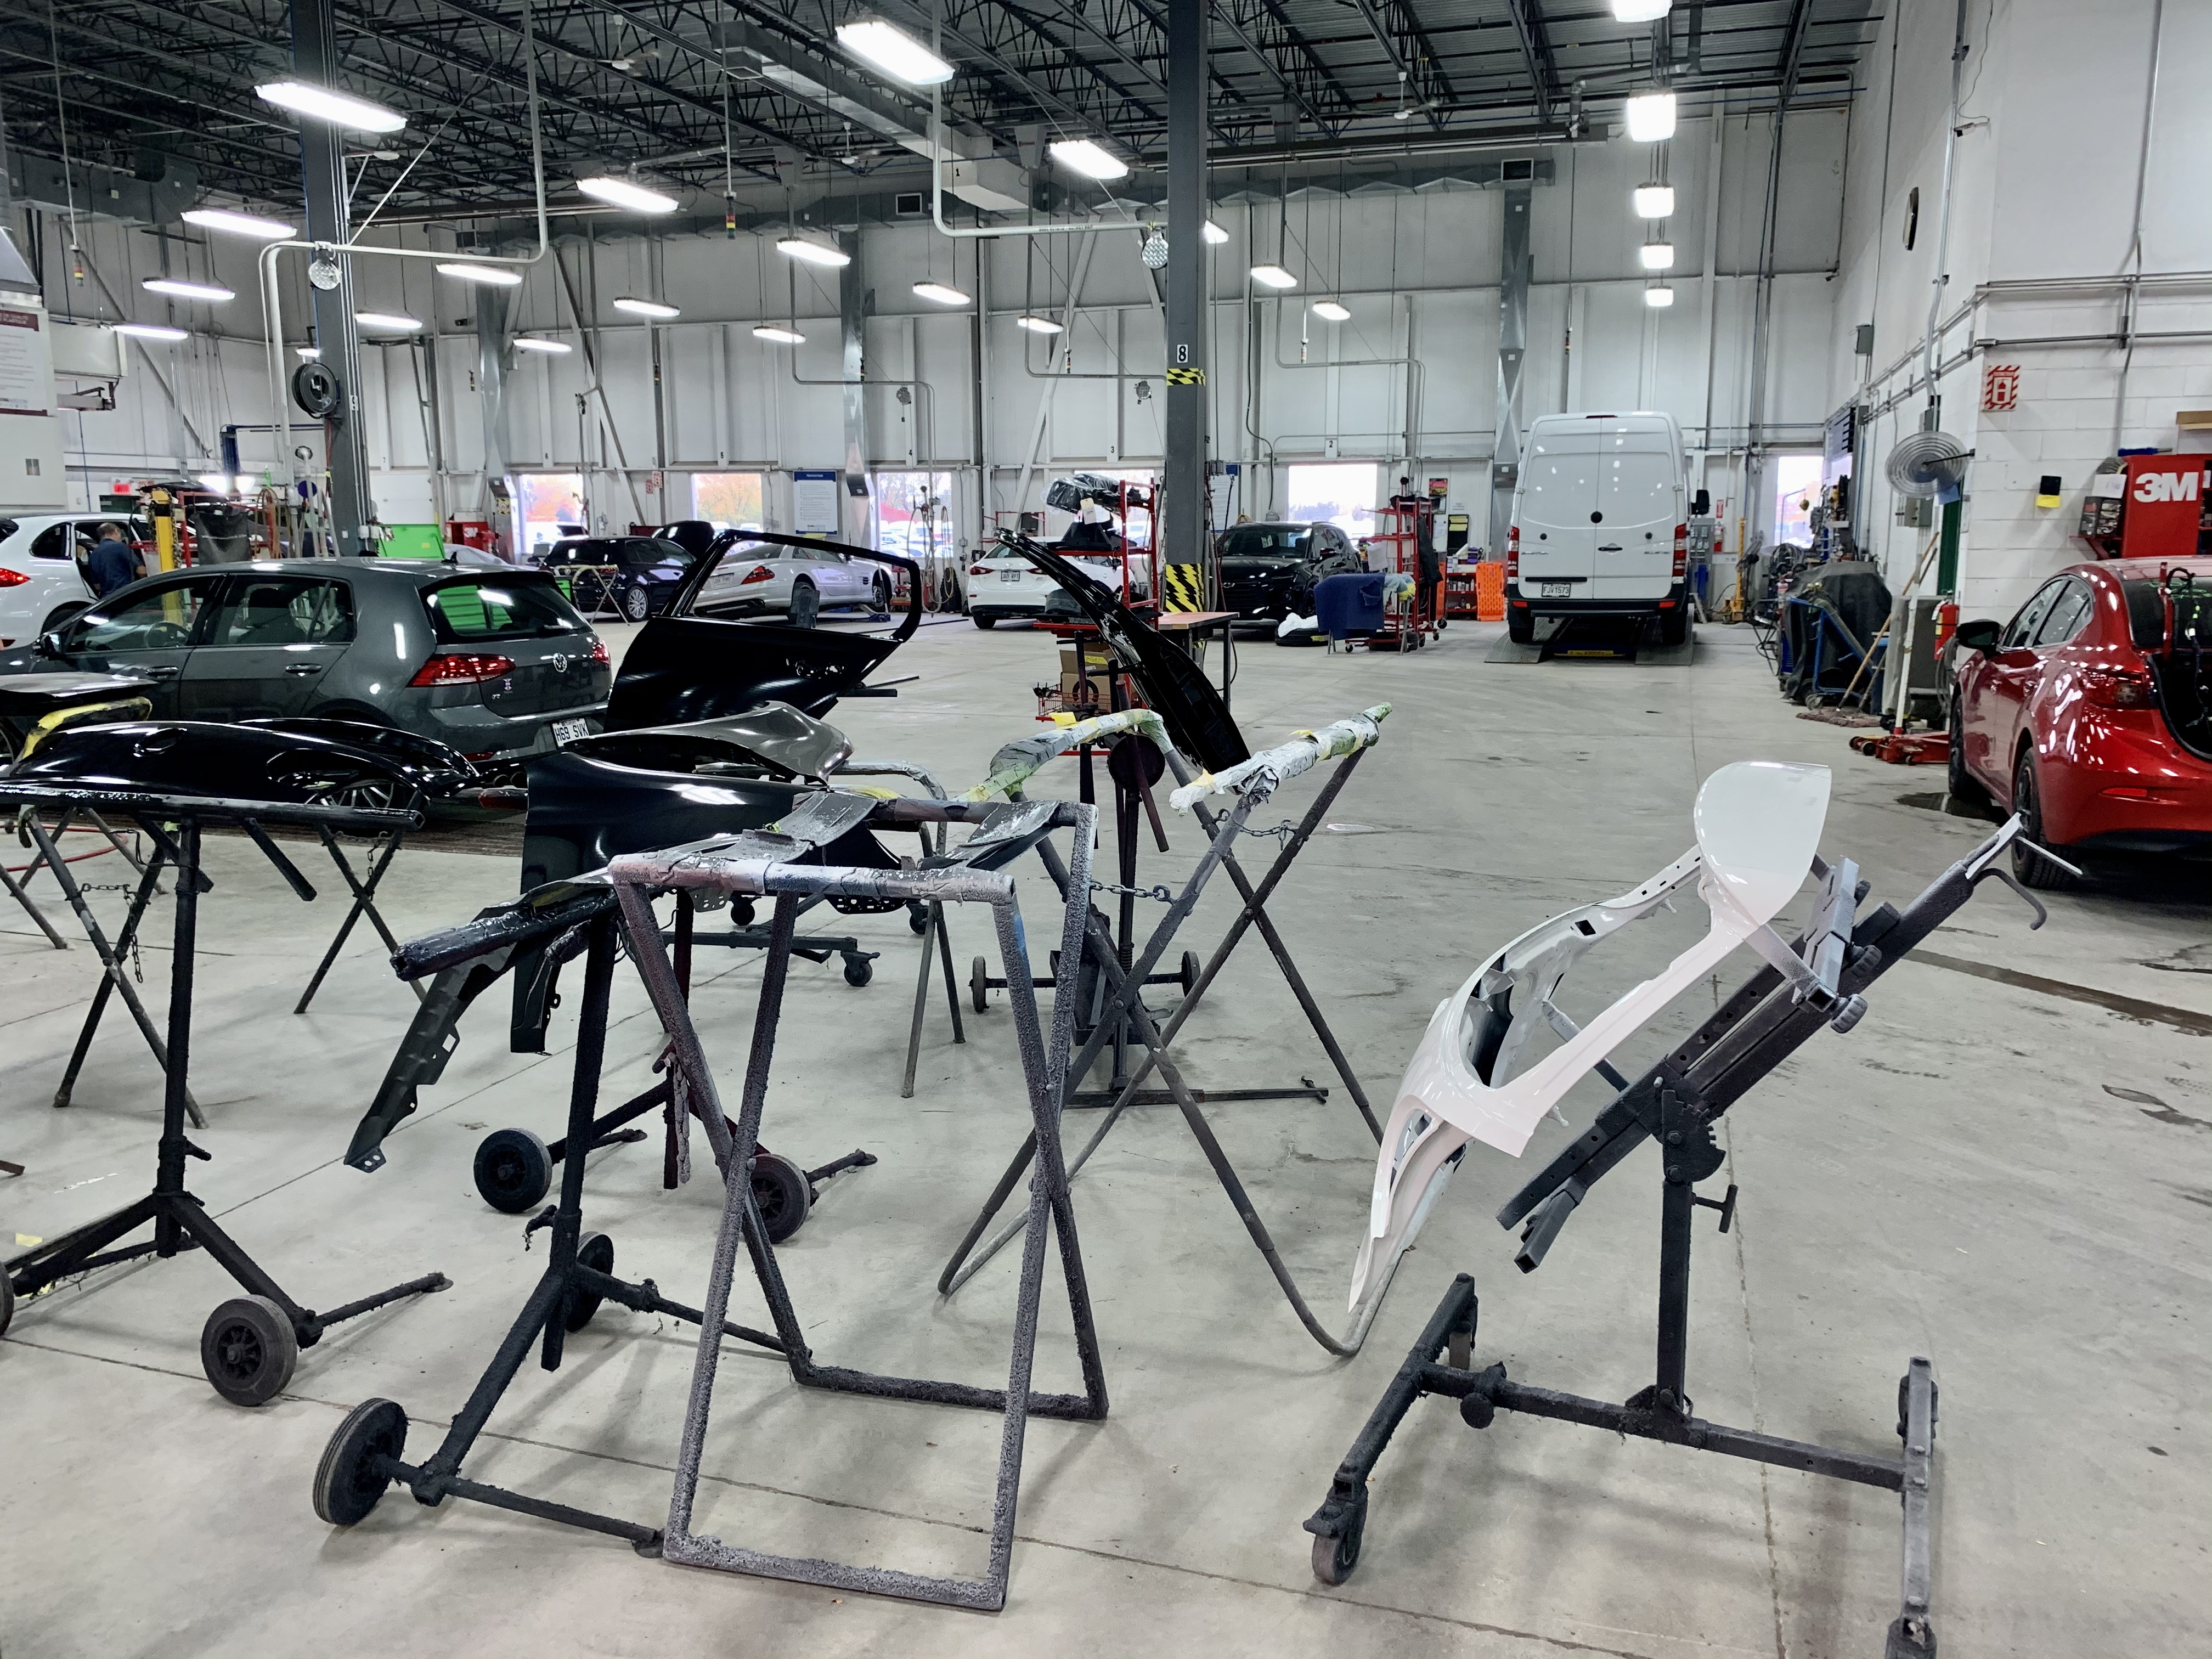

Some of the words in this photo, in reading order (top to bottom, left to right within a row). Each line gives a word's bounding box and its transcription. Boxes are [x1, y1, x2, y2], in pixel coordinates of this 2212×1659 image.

[1178, 346, 1186, 362] 8
[2134, 472, 2199, 503] 3M
[555, 726, 571, 741] H69
[573, 723, 588, 737] SVK
